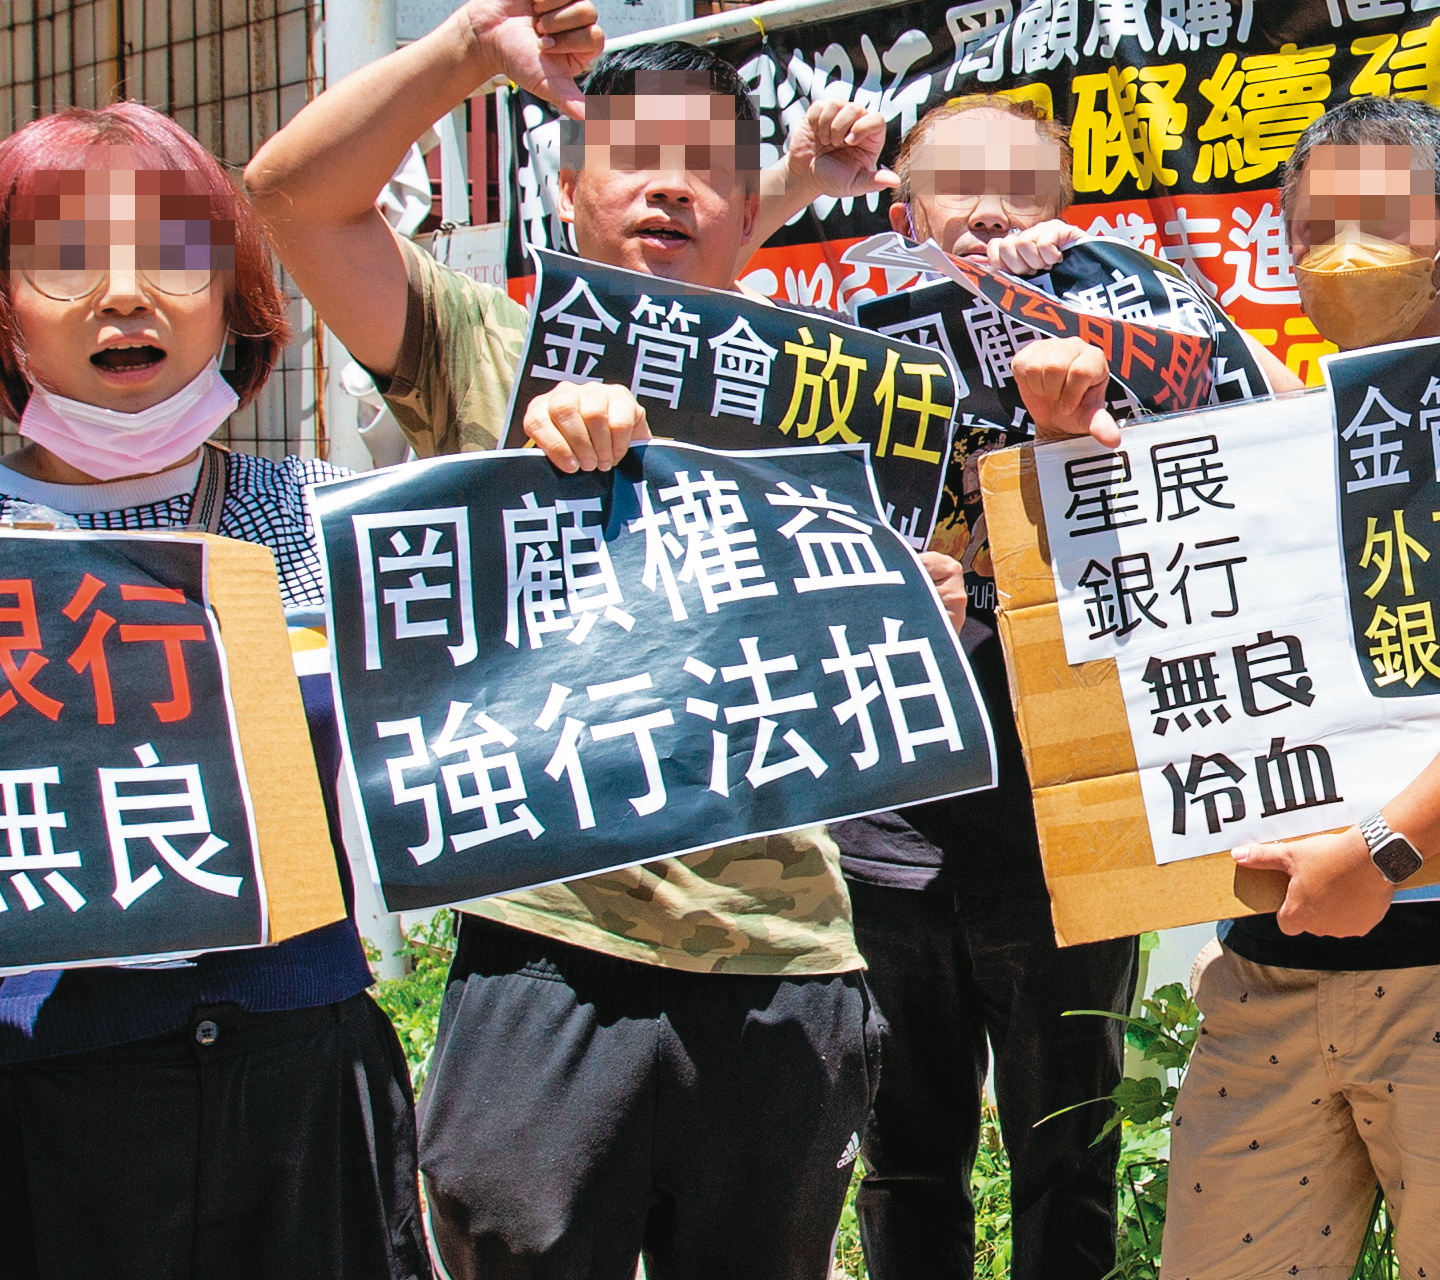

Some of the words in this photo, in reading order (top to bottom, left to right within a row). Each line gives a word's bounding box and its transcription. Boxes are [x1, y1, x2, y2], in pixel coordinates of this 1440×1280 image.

[531, 275, 954, 465] 金管會放任
[1064, 432, 1236, 539] 星展
[352, 469, 906, 672] 罔顧權益
[1076, 534, 1250, 642] 銀行
[1149, 630, 1317, 738] 無良
[376, 616, 964, 867] 強行法拍
[1160, 735, 1344, 838] 冷血
